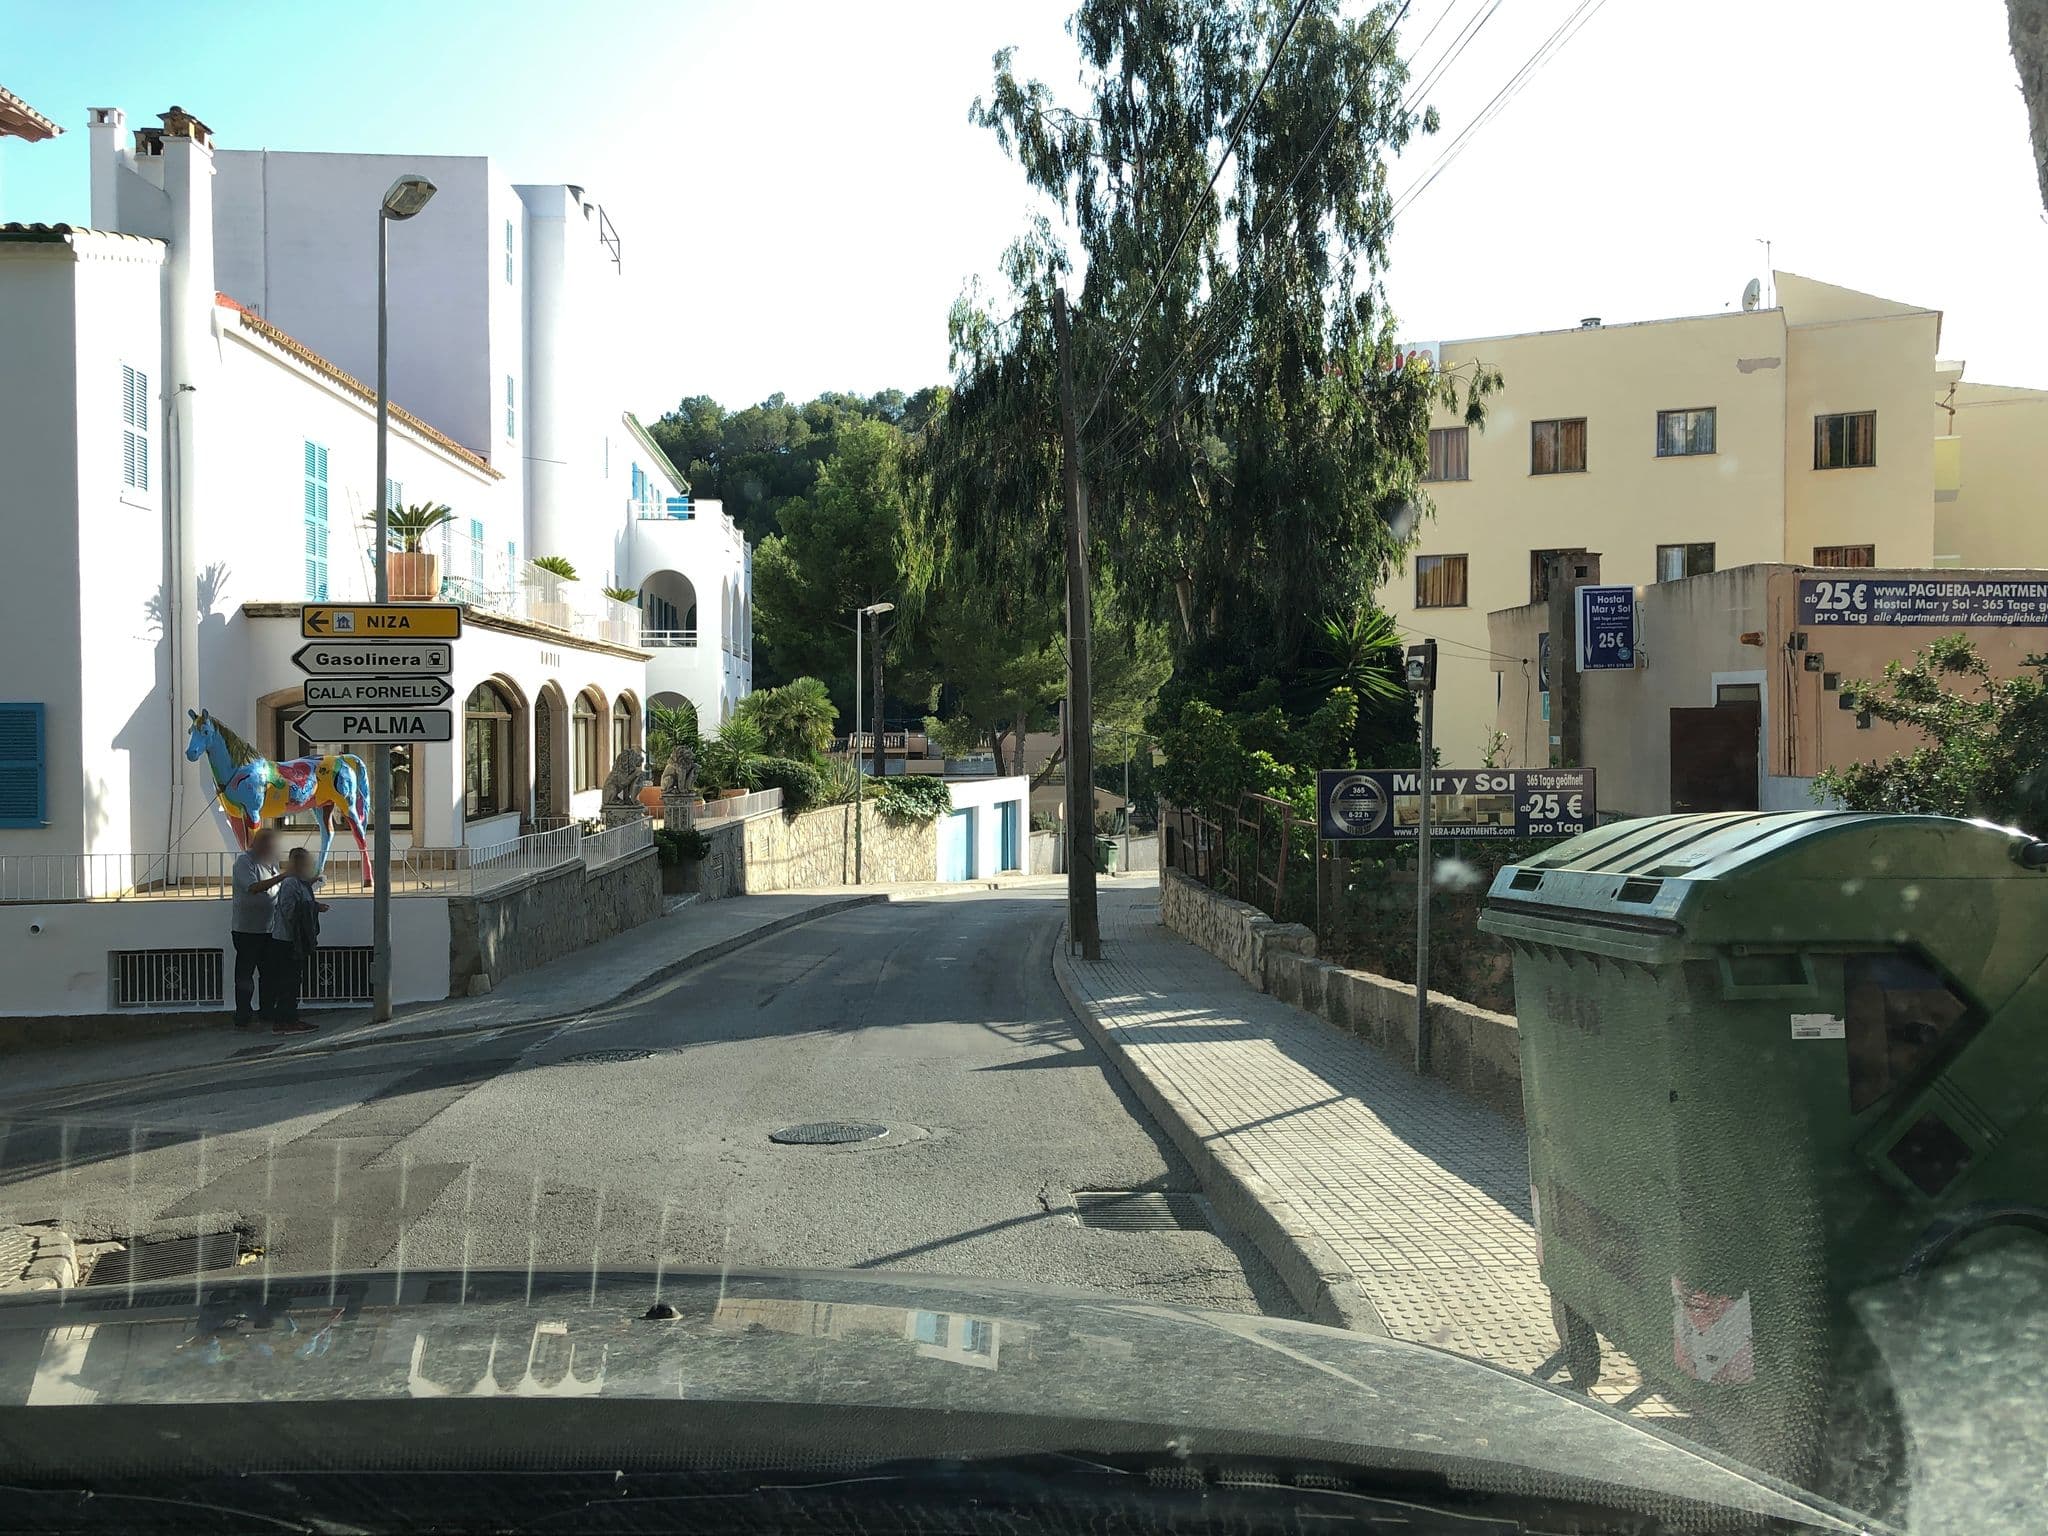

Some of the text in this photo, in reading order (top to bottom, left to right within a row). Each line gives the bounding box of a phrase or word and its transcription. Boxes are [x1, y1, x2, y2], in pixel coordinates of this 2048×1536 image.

[1804, 582, 1867, 610] ab 25€
[1874, 583, 2048, 598] www.PAGUERA-APARTMEN
[1597, 594, 1625, 604] Hostal
[1874, 599, 1911, 609] Hostal
[1915, 600, 1939, 609] Mar
[1942, 602, 1949, 612] y
[1952, 599, 1970, 609] Sol
[1982, 600, 2004, 609] 365
[2008, 600, 2035, 612] Tage
[1591, 604, 1631, 614] Mar y Sol
[367, 616, 411, 629] NIZA
[1815, 611, 1867, 623] pro Tag
[1873, 612, 1892, 622] alle
[1894, 612, 1950, 624] Apartments
[1952, 612, 1968, 622] mit
[1598, 632, 1625, 648] 25€
[316, 653, 421, 666] Gasolinera
[308, 685, 442, 699] CALA FORNELLS
[343, 716, 426, 734] PALMA
[1452, 778, 1468, 795] y
[1475, 773, 1516, 791] Sol
[1527, 774, 1538, 786] 365
[1539, 774, 1555, 789] Tage
[1520, 804, 1531, 812] ab
[1529, 794, 1560, 819] 25
[1393, 827, 1516, 836] www.PUERA-APARTMENTS.com
[1529, 821, 1584, 836] pro Tag
